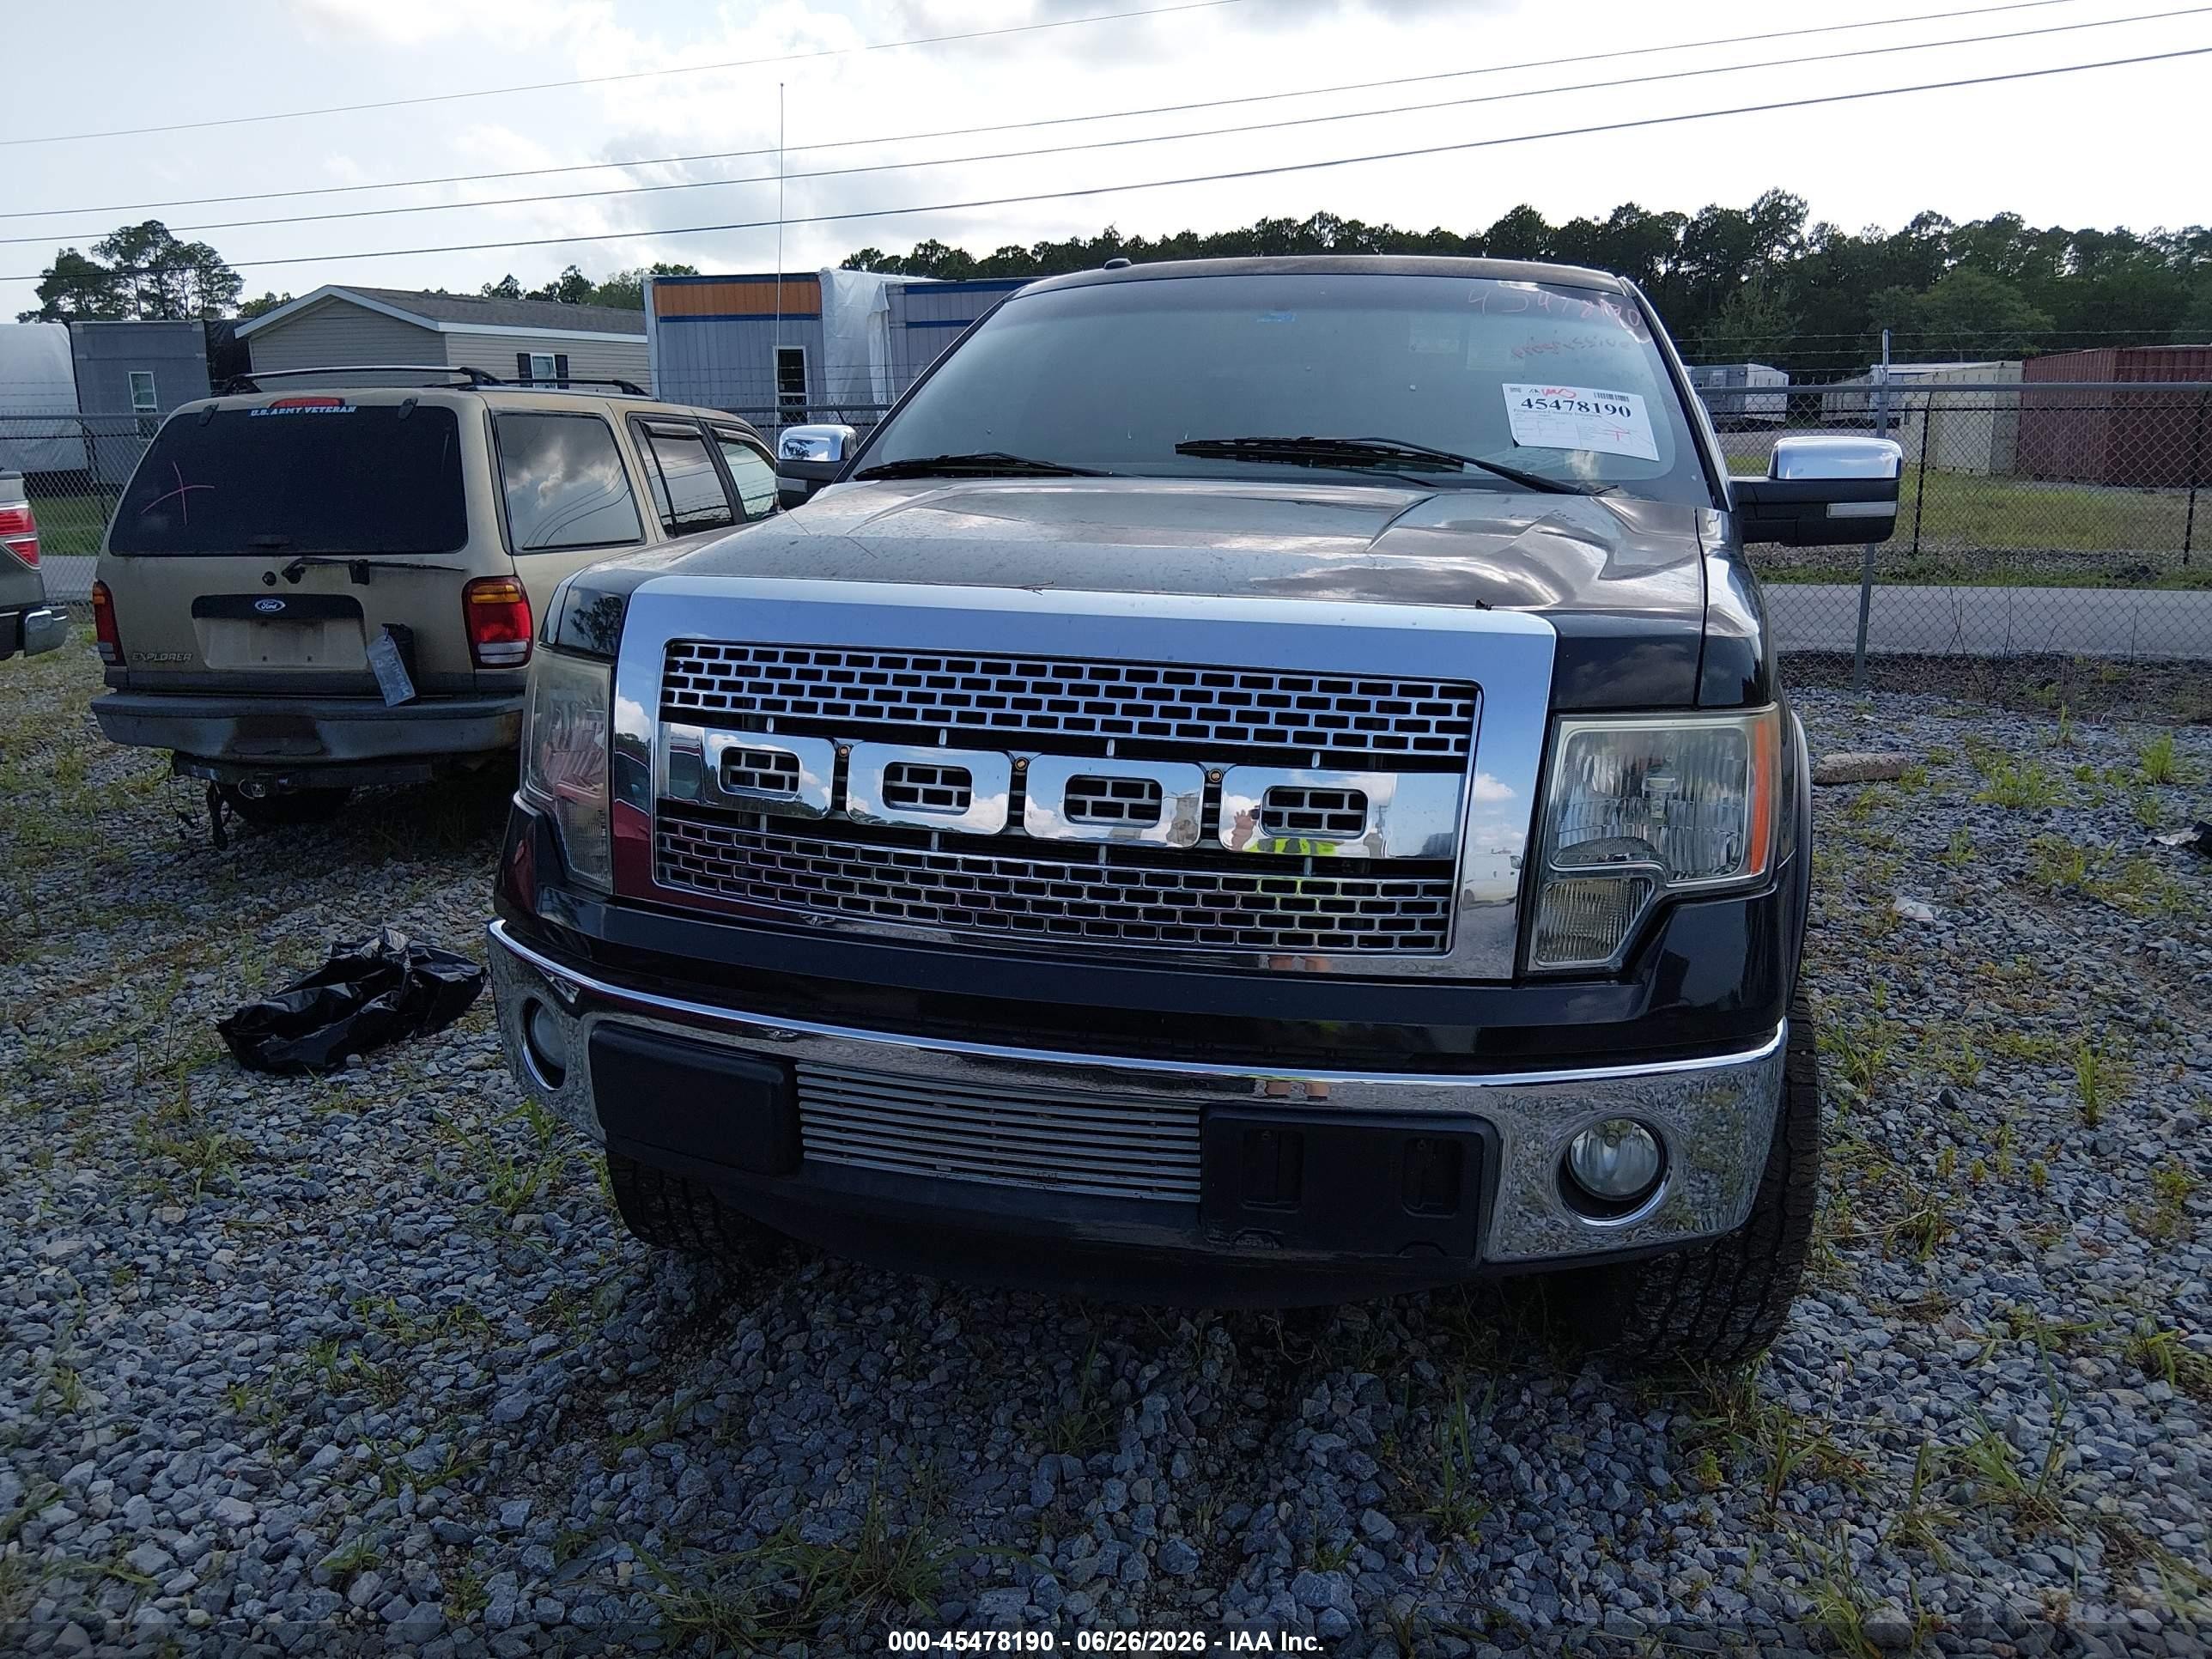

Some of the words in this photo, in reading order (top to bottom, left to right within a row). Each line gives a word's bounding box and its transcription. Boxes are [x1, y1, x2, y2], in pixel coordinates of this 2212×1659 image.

[270, 407, 303, 416] ARMY
[1521, 398, 1632, 418] 45478190
[261, 599, 278, 610] Ford
[131, 652, 192, 662] EXPLORER
